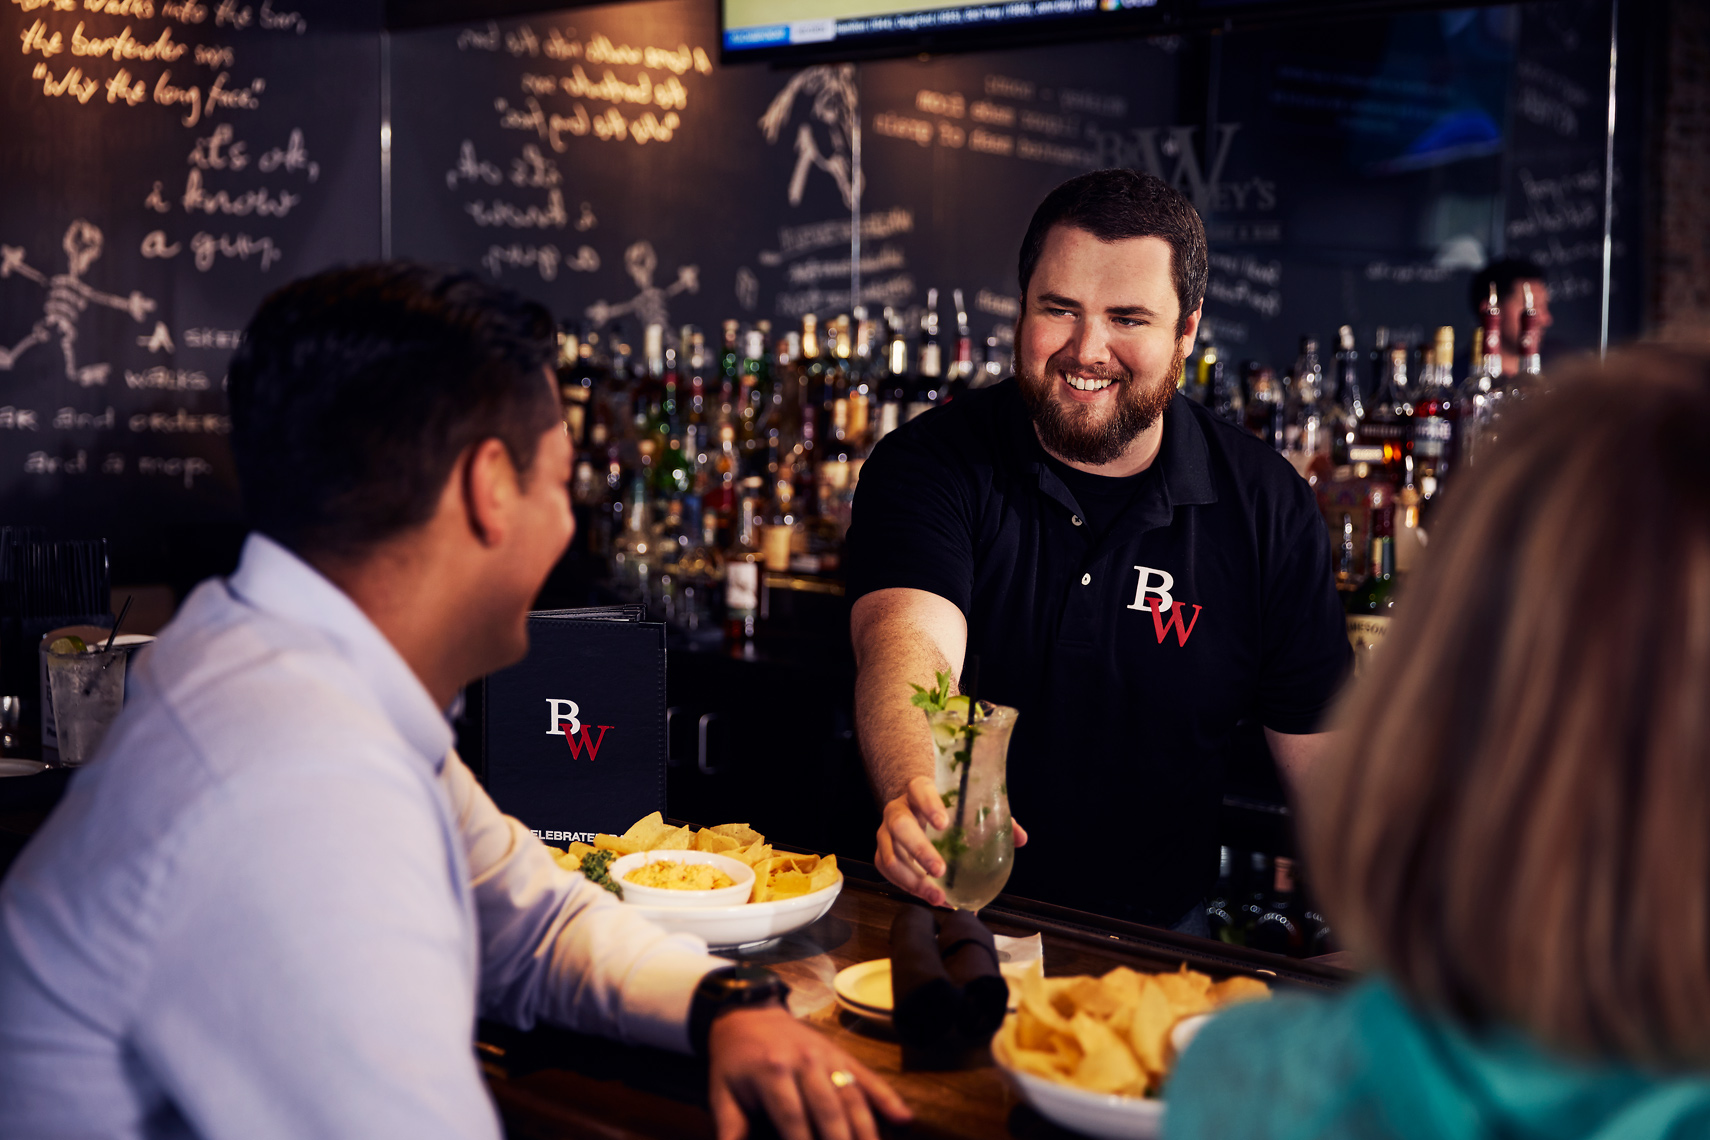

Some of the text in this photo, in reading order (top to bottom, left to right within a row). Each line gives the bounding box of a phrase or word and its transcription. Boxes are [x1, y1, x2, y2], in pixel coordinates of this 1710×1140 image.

[214, 0, 252, 30] the
[20, 18, 63, 58] the
[71, 20, 188, 62] bartender
[105, 67, 147, 107] the
[153, 68, 201, 128] long
[182, 166, 299, 218] know
[140, 230, 182, 259] a
[530, 829, 598, 842] ELEBRATE
